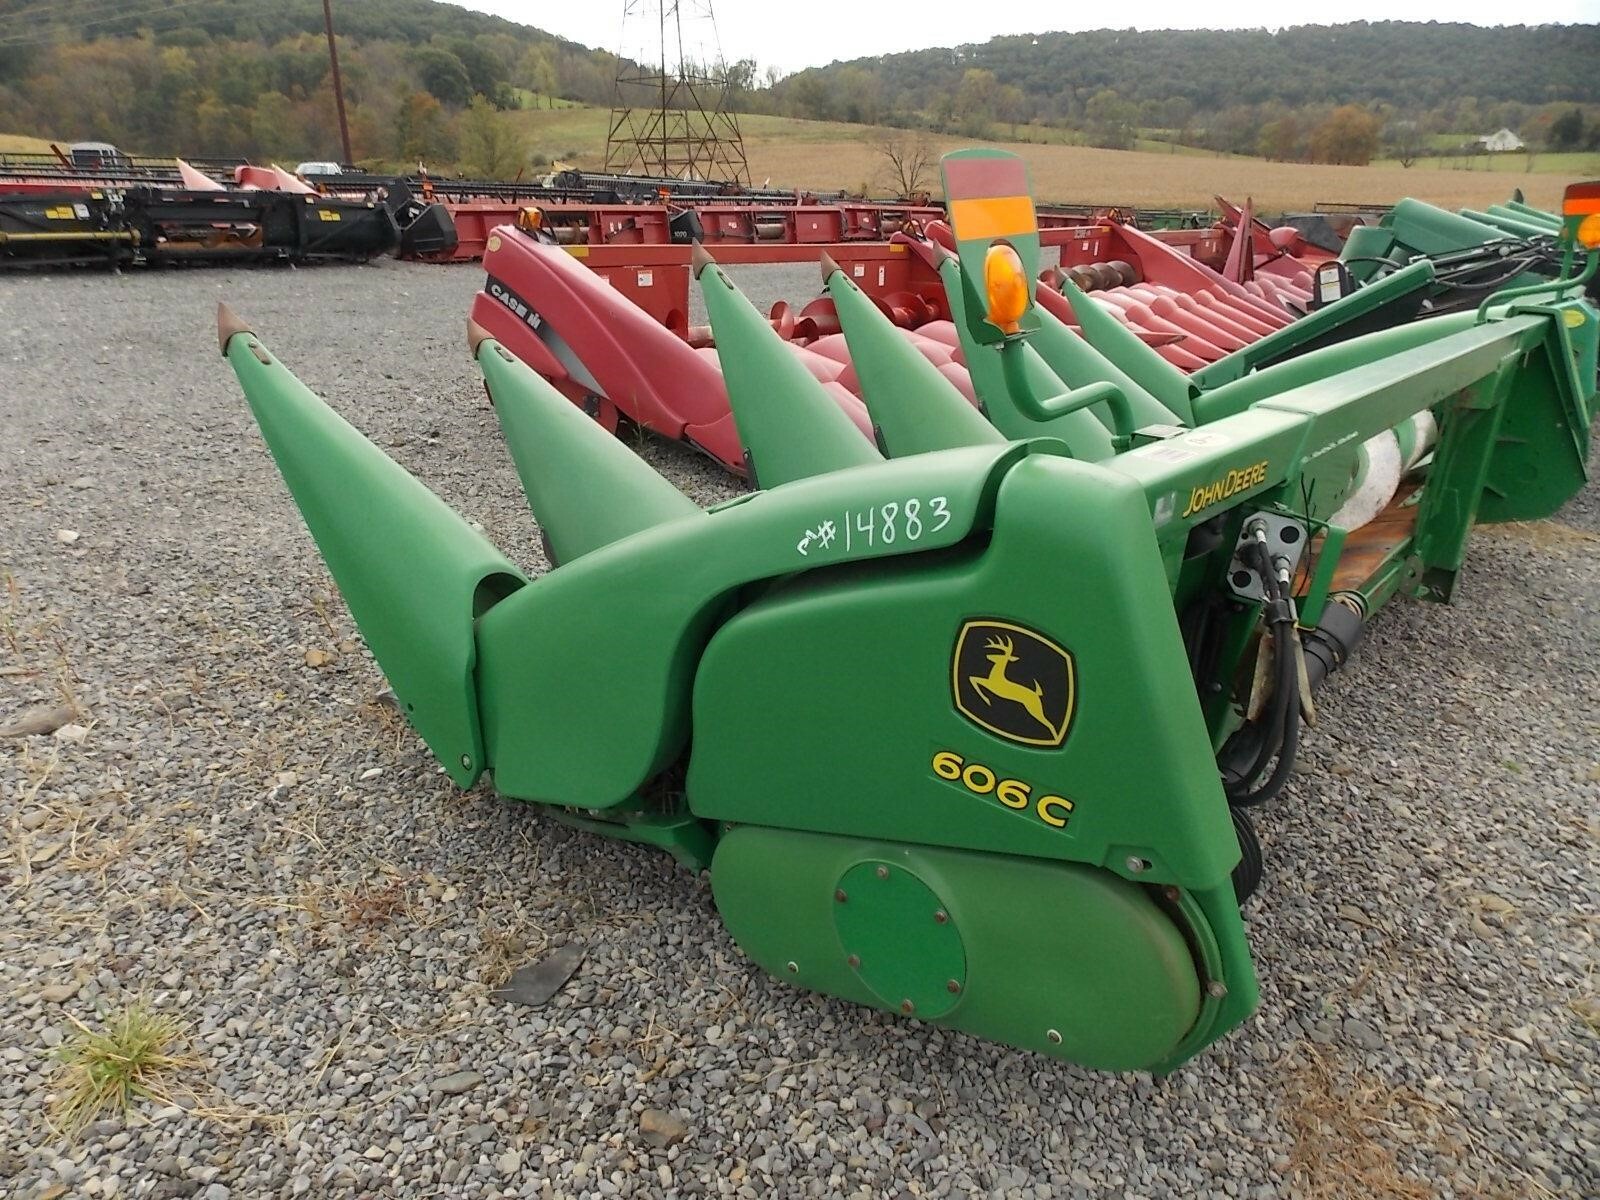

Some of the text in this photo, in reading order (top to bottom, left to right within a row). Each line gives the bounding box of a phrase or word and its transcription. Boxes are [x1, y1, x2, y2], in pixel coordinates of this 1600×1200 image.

[491, 284, 528, 318] CASE
[1182, 461, 1269, 519] JOHN DEERE
